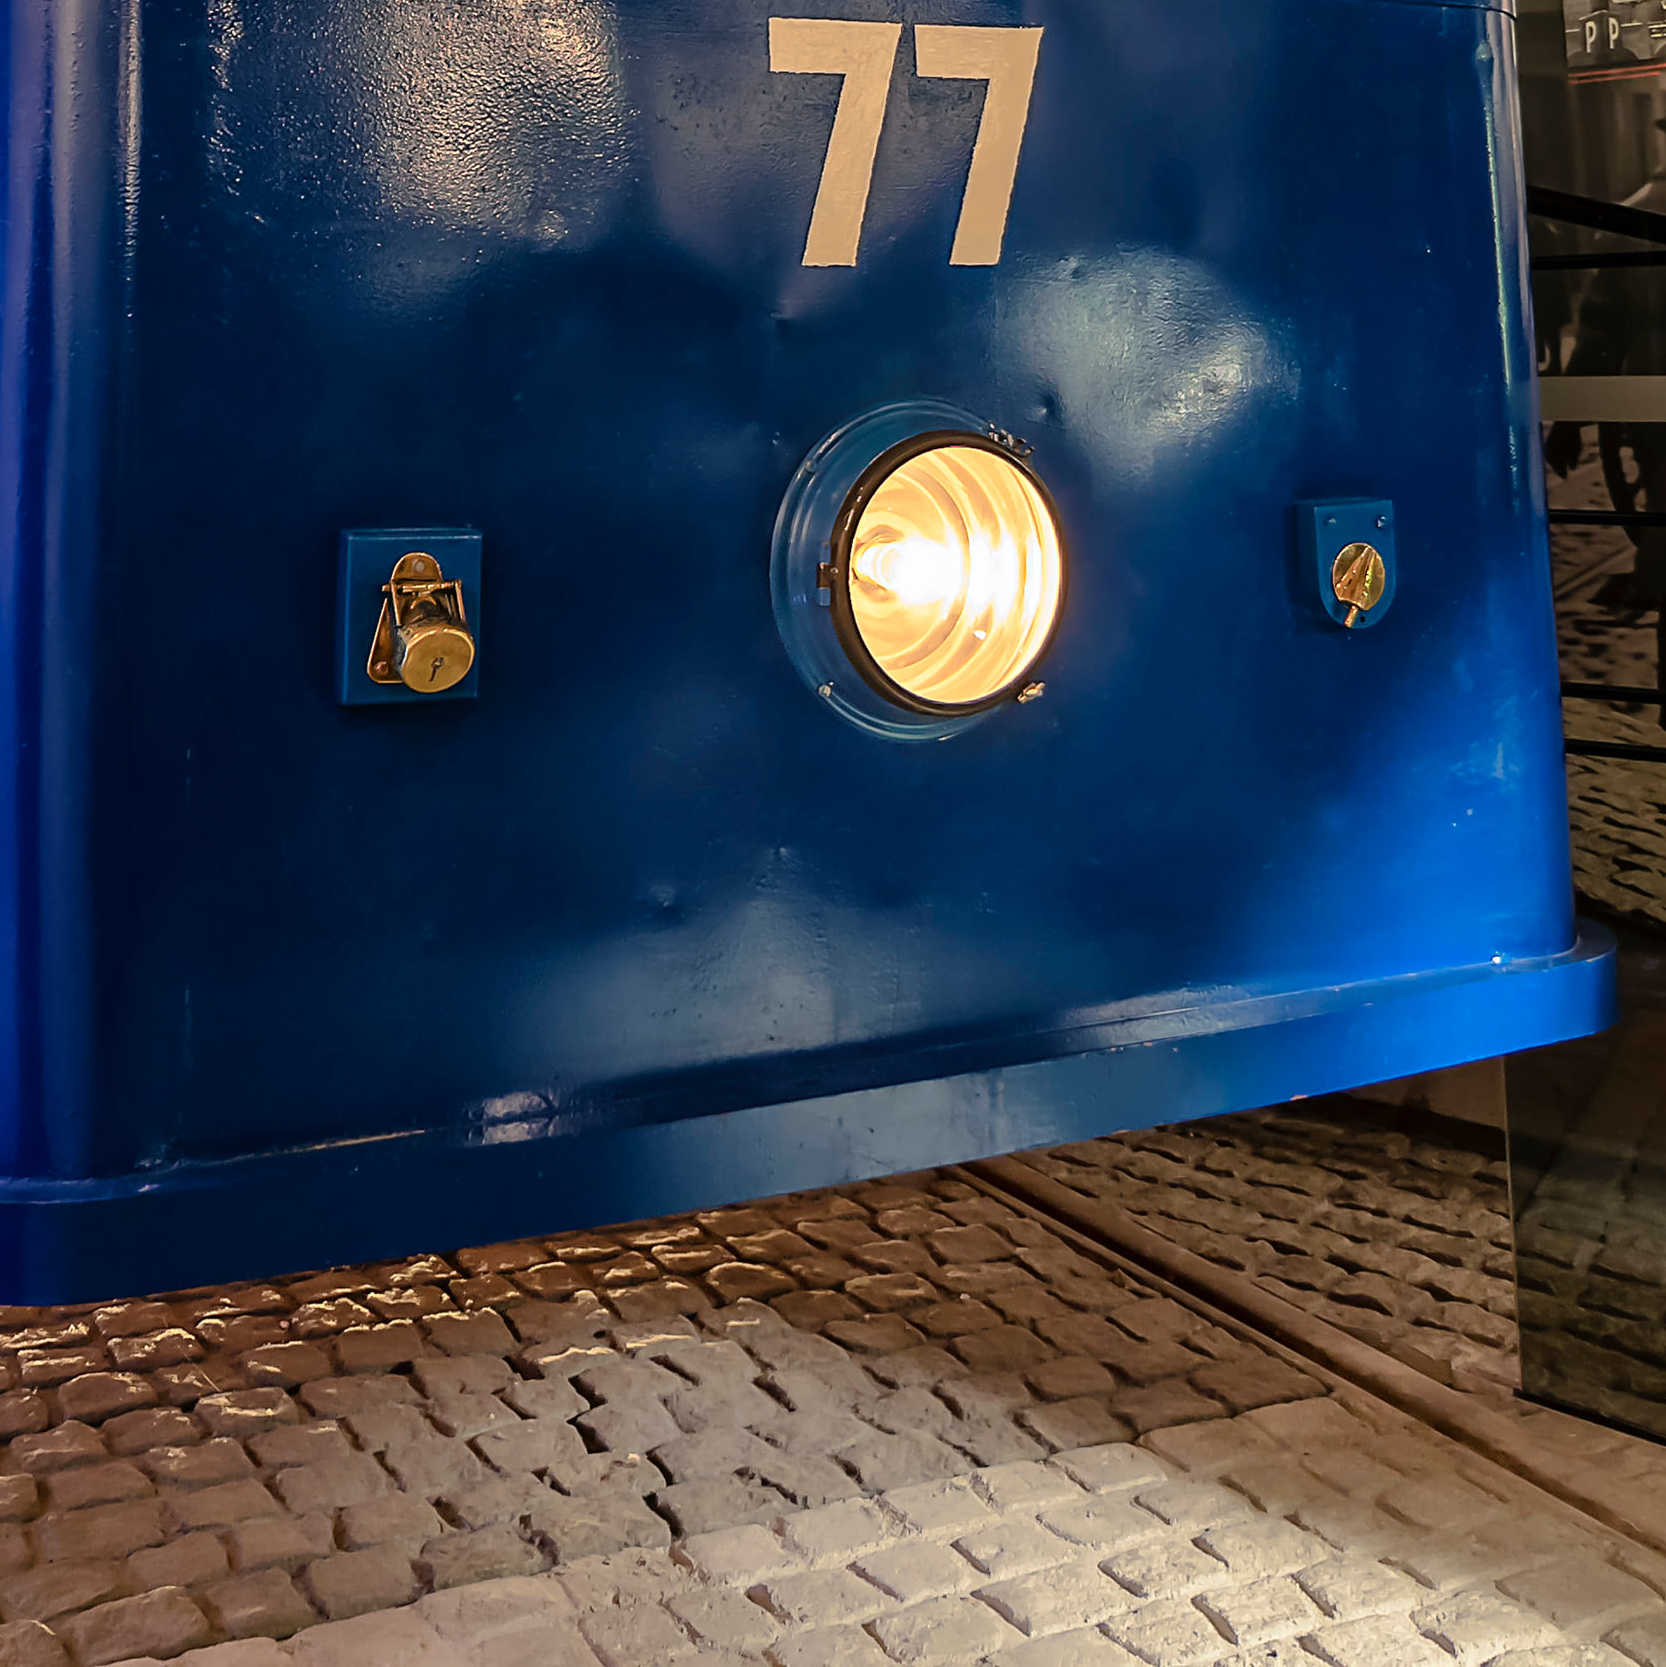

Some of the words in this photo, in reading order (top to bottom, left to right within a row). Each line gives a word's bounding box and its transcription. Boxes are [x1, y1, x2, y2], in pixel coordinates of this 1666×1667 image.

[1585, 20, 1595, 54] P
[1608, 17, 1619, 50] P
[766, 15, 1044, 268] 77
